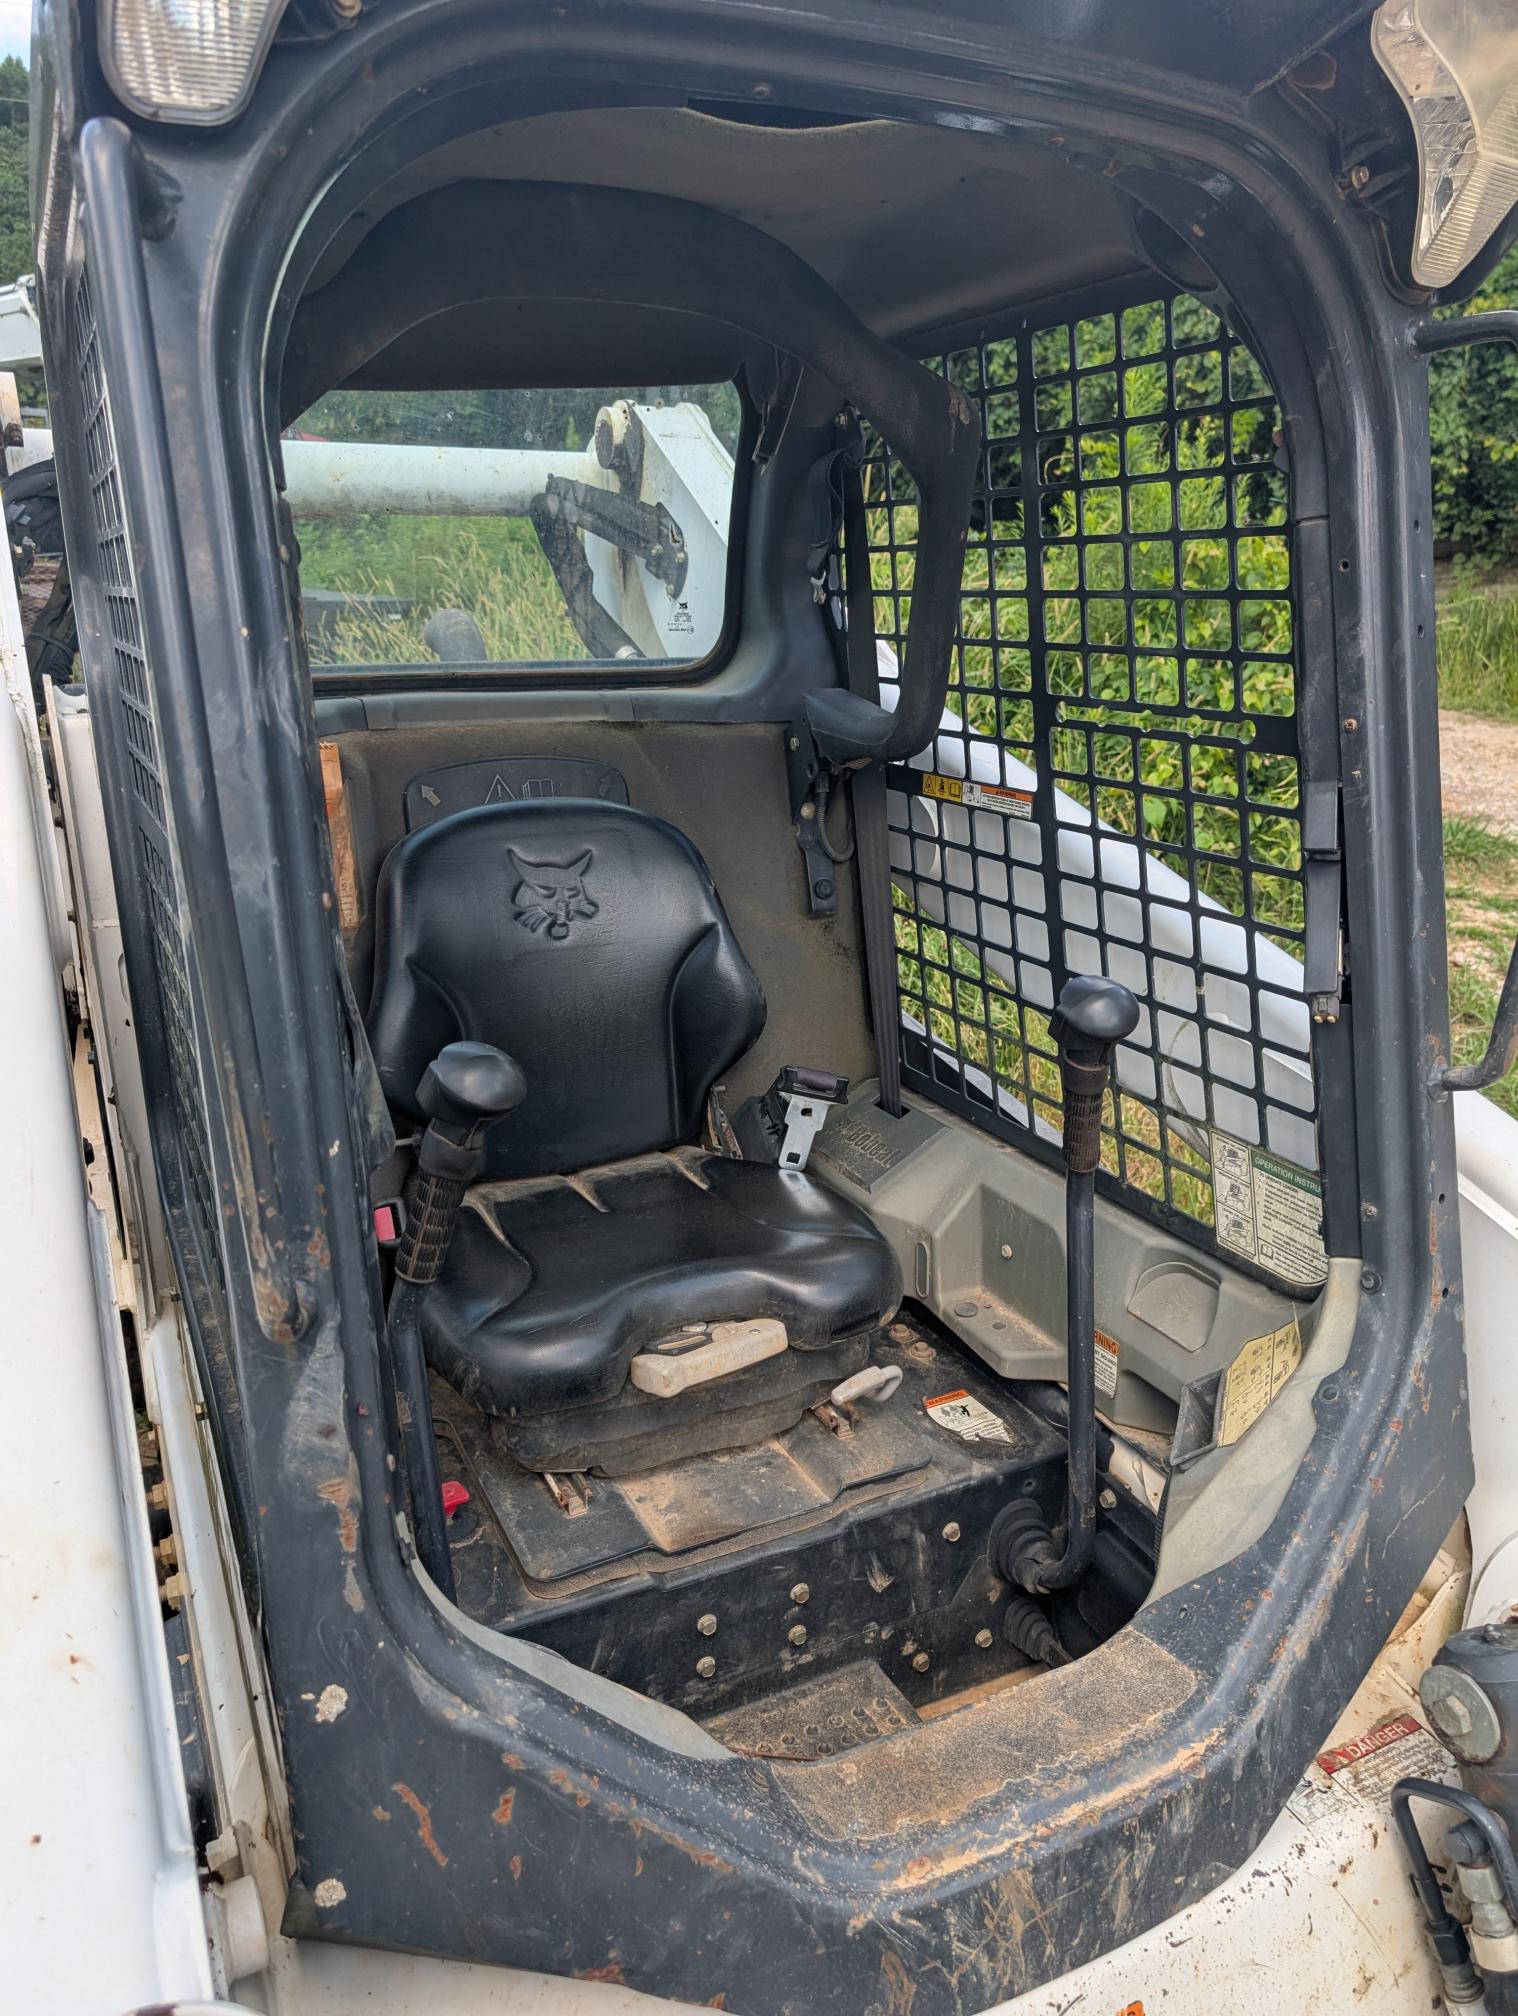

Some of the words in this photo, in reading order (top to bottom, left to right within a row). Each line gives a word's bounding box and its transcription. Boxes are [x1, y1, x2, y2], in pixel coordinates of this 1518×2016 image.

[846, 1124, 901, 1168] Bobcat
[1254, 1156, 1293, 1180] OPERATION
[1294, 1174, 1321, 1193] INSTRU
[1094, 1330, 1116, 1353] RNING
[927, 1391, 963, 1405] WARNING
[1345, 1722, 1409, 1758] DANGER
